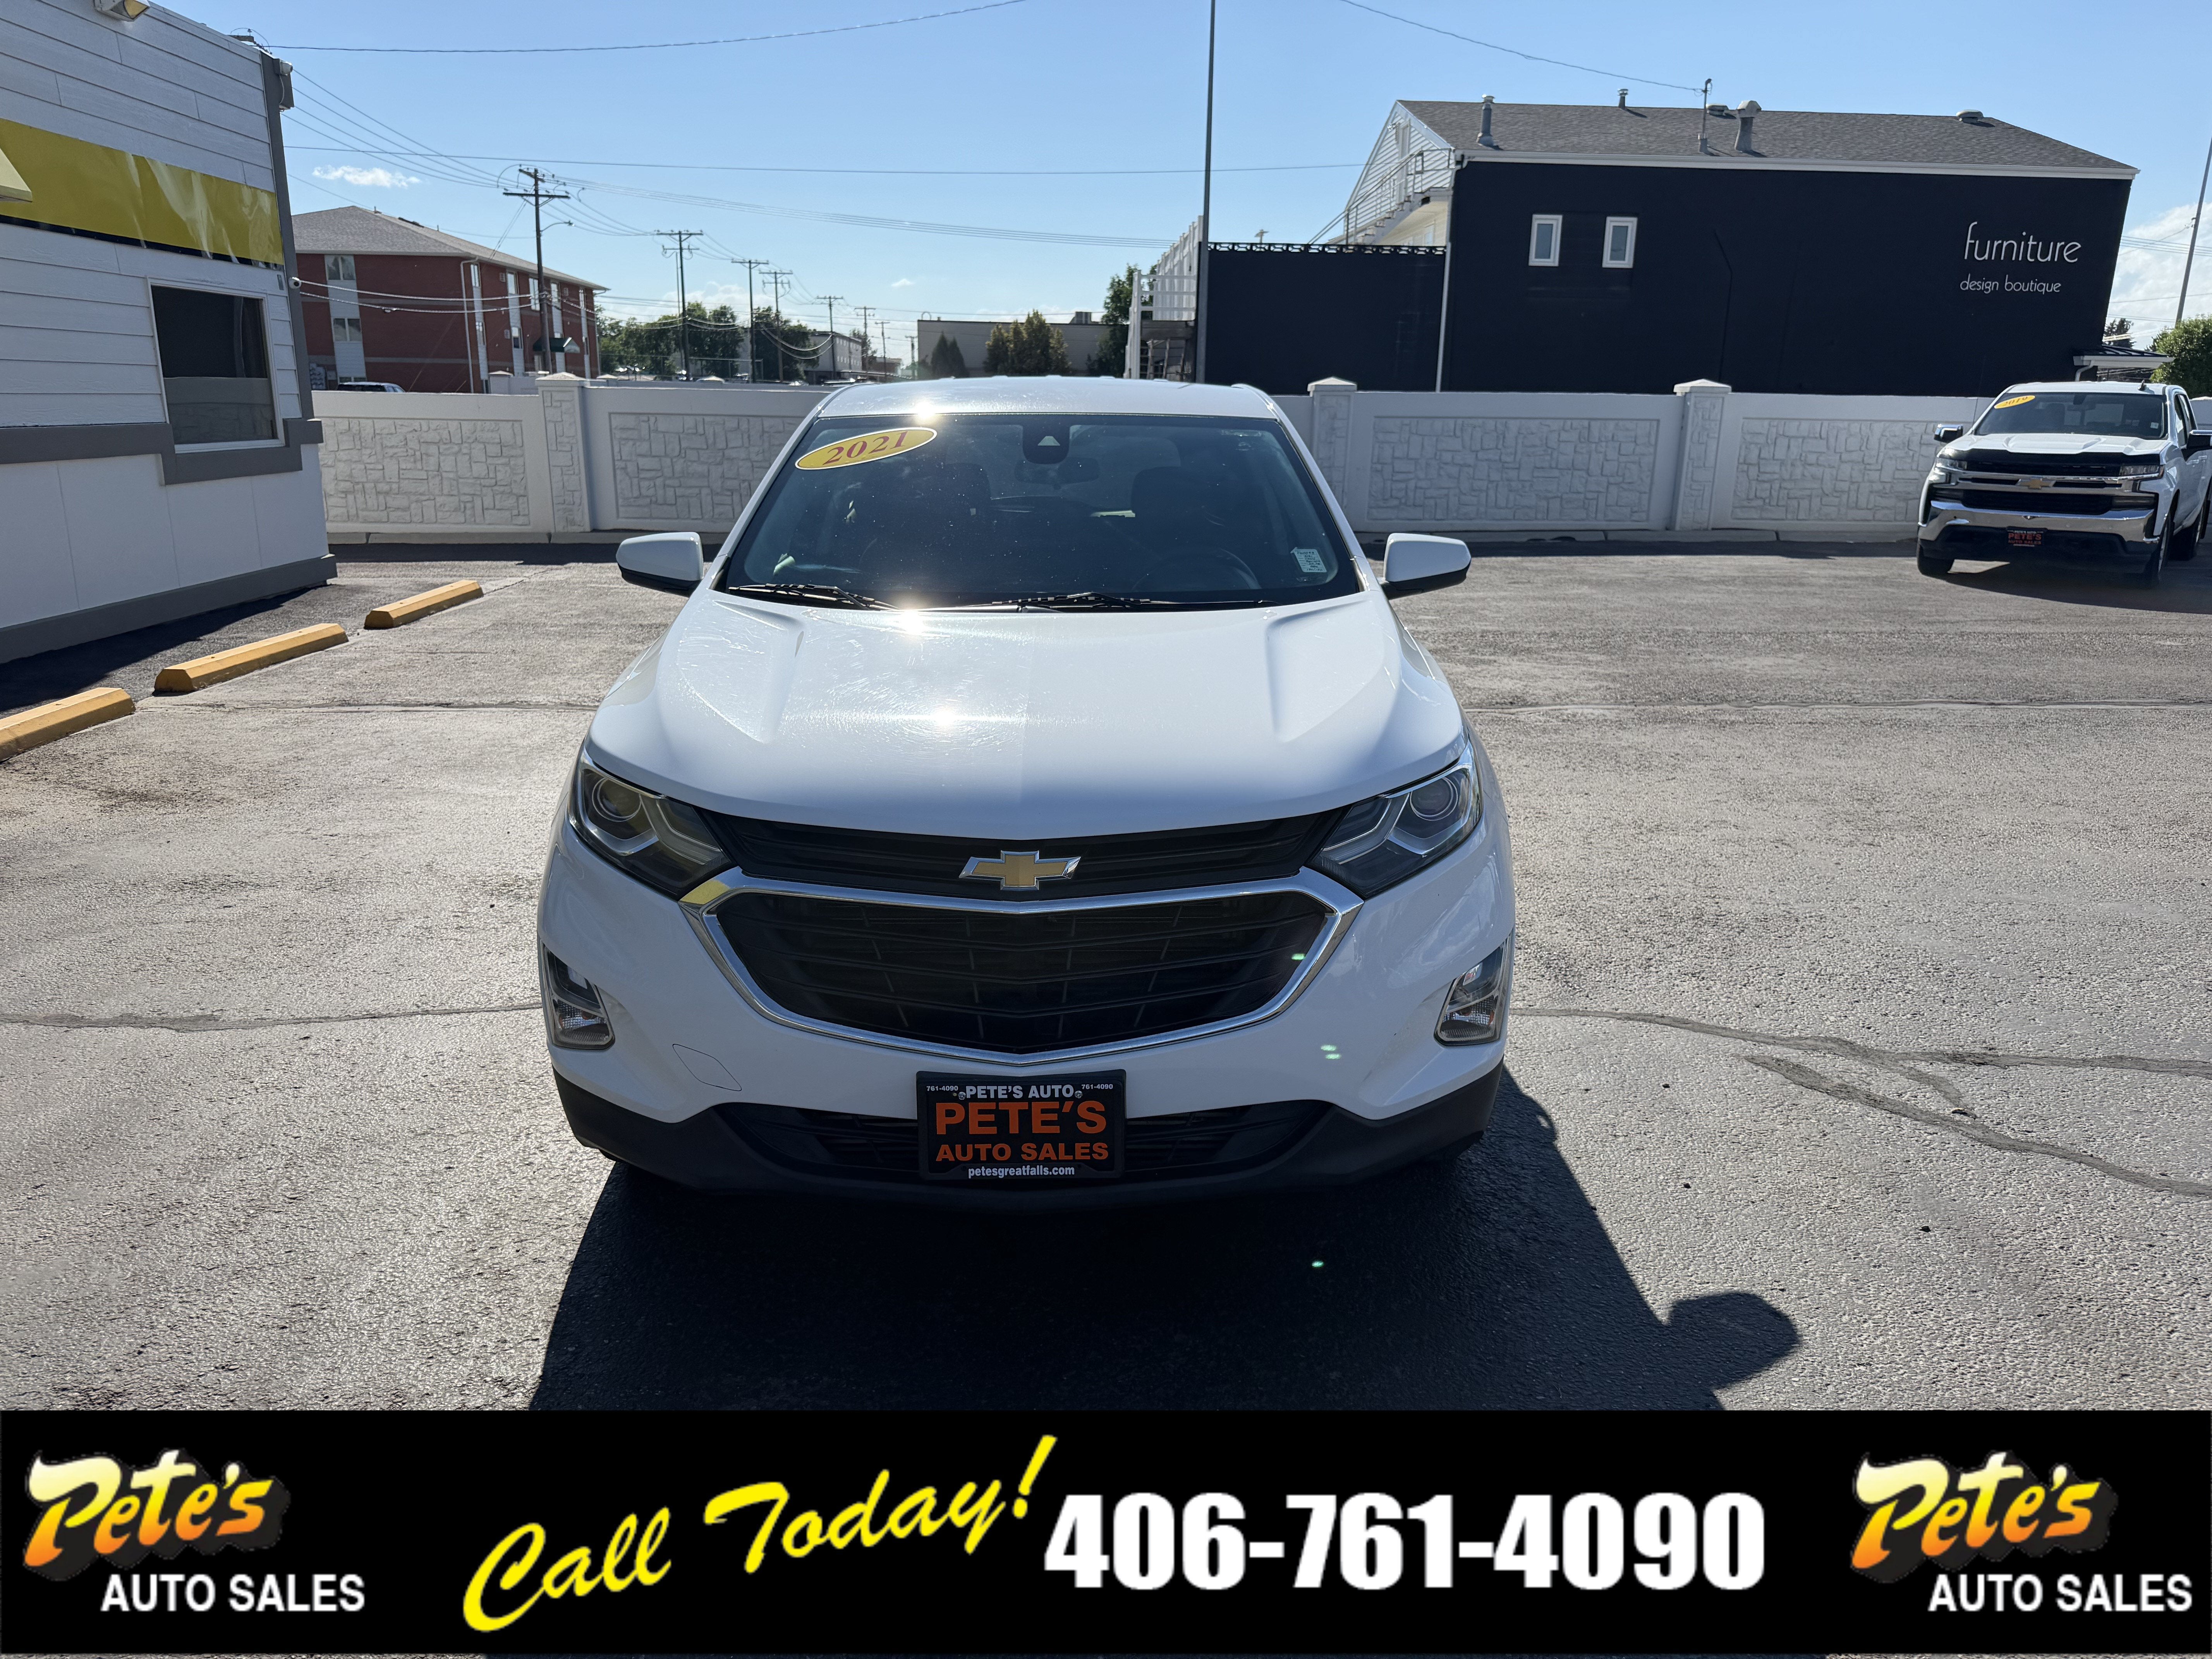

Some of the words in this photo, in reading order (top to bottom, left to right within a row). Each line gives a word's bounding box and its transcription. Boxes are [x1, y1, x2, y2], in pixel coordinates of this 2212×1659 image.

[1964, 221, 2081, 263] furniture
[1960, 273, 1999, 294] design
[2004, 275, 2061, 295] boutique
[823, 431, 908, 465] 2021
[966, 1085, 1023, 1098] PETE'S
[1028, 1084, 1074, 1098] AUTO
[936, 1101, 1106, 1135] PETE'S
[936, 1144, 1011, 1161] AUTO
[1021, 1142, 1109, 1160] SALES
[968, 1165, 1075, 1179] petesgreatfalls.com
